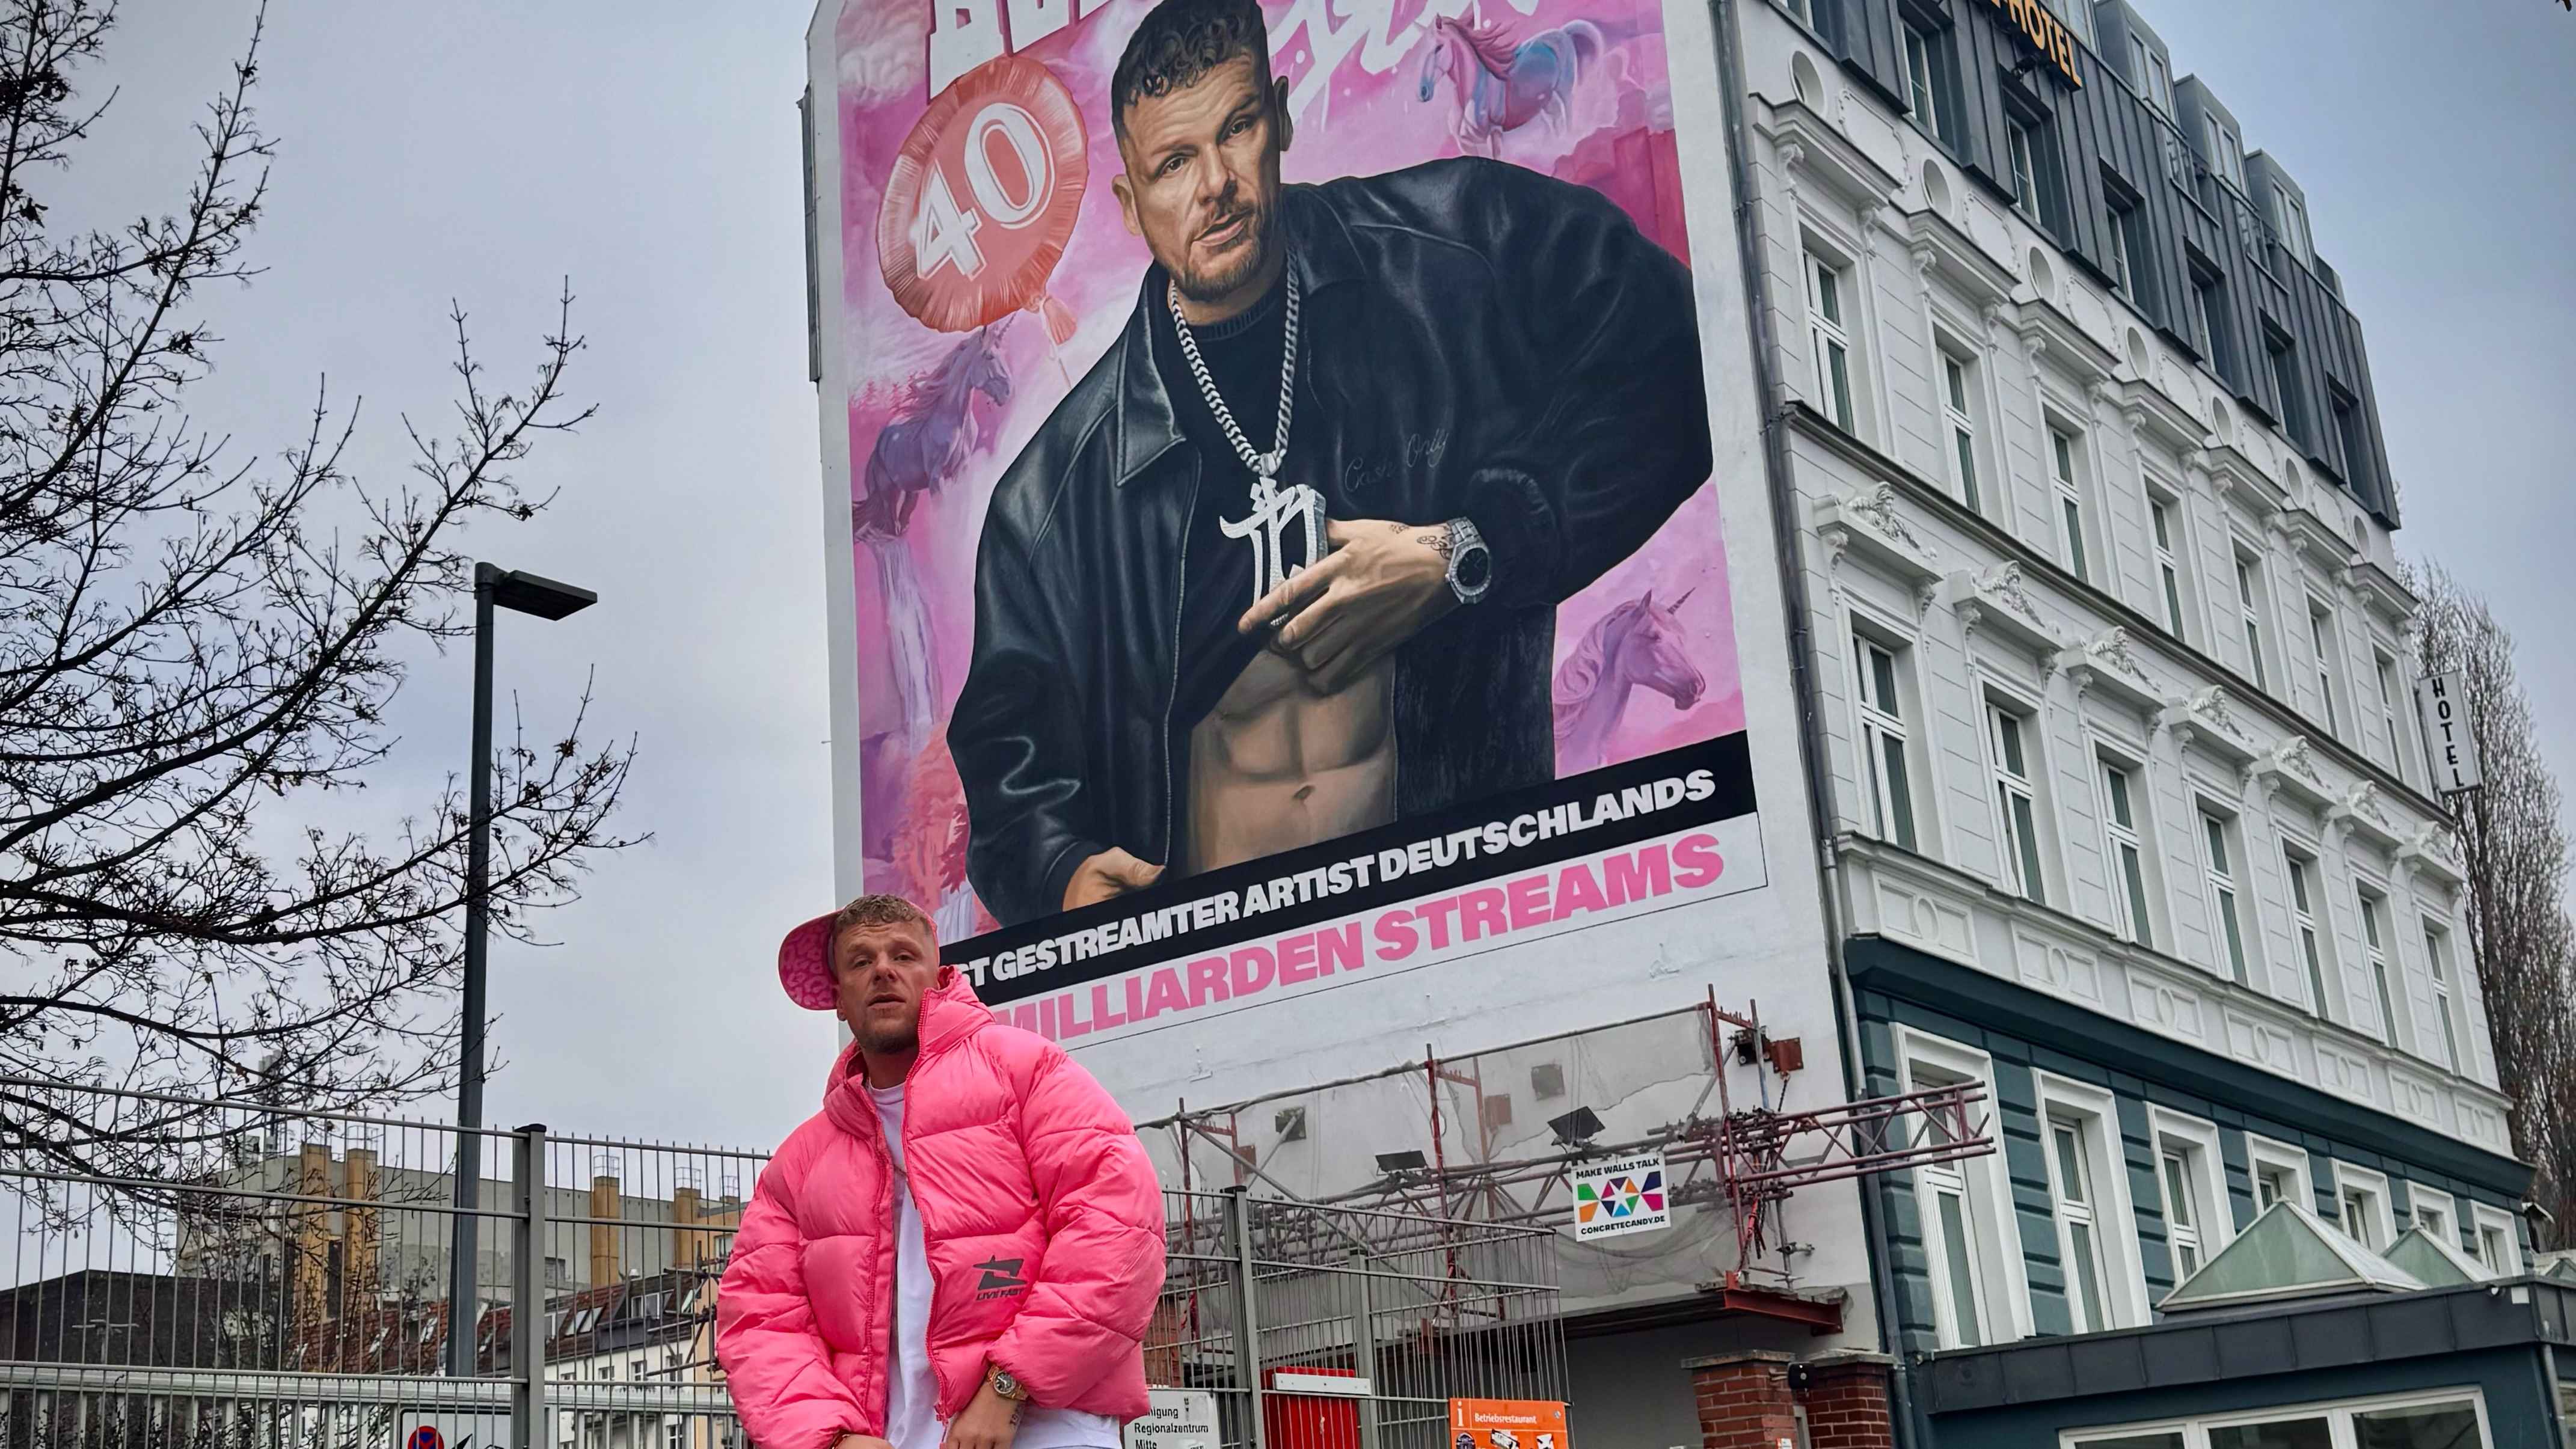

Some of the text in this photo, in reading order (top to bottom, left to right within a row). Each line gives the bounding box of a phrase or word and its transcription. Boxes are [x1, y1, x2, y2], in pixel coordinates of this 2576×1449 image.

[909, 102, 1055, 281] 40
[2432, 677, 2464, 788] HOTEL
[992, 891, 1240, 981] GESTREAMTER
[1243, 854, 1375, 917] ARTIST
[1379, 769, 1716, 882] DEUTSCHLANDS
[1373, 833, 1725, 961] STREAMS
[1576, 1158, 1660, 1179] MAKE WALLS TALK
[1581, 1216, 1665, 1235] CONCRETECANDY.DE
[1474, 1412, 1538, 1424] Betriebsrestaurant
